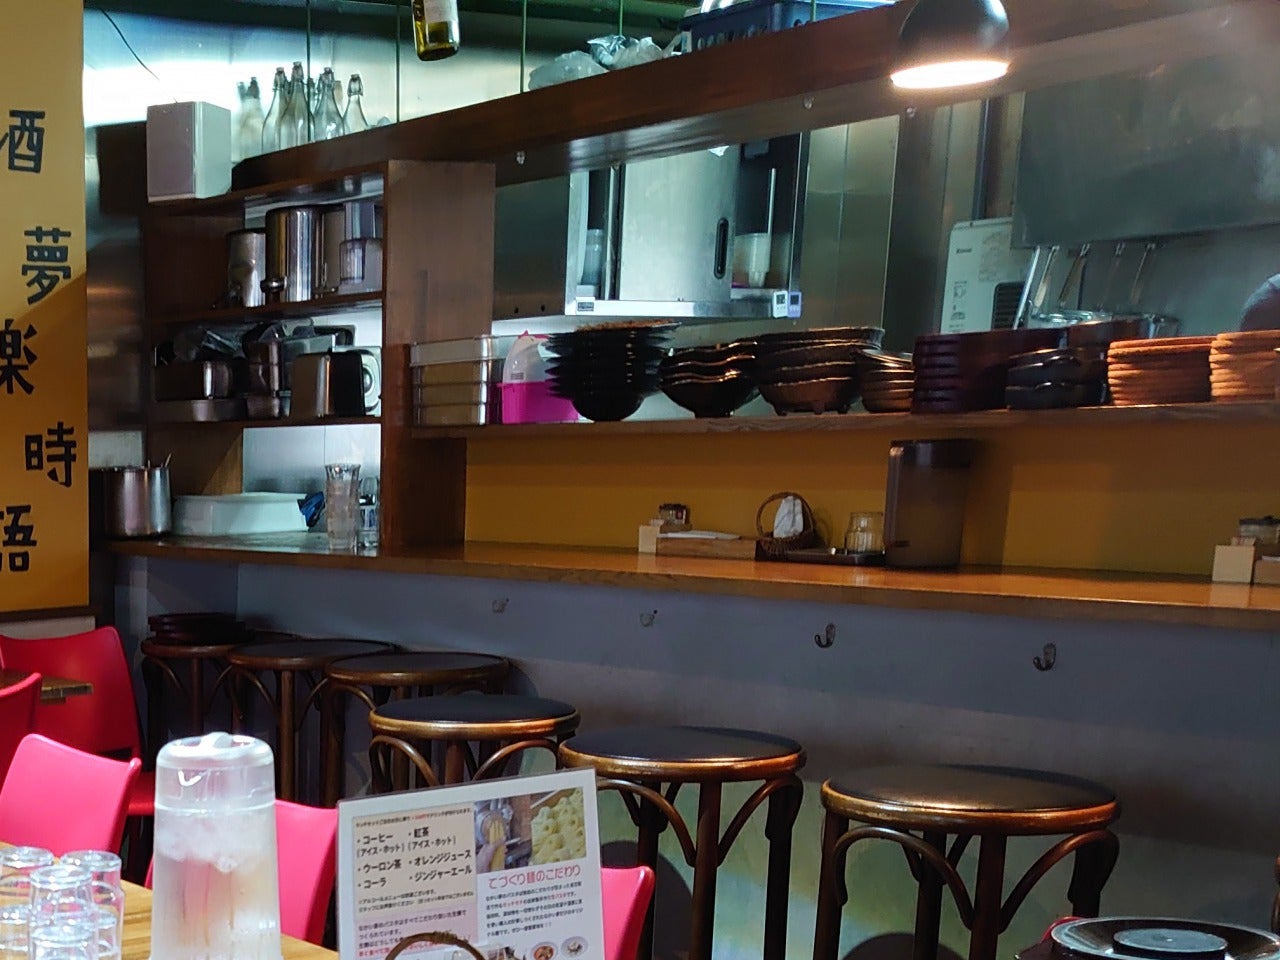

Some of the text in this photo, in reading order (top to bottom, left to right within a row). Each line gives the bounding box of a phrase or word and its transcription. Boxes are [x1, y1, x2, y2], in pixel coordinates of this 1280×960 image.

[489, 864, 582, 890] てづくり麺のこだわり
